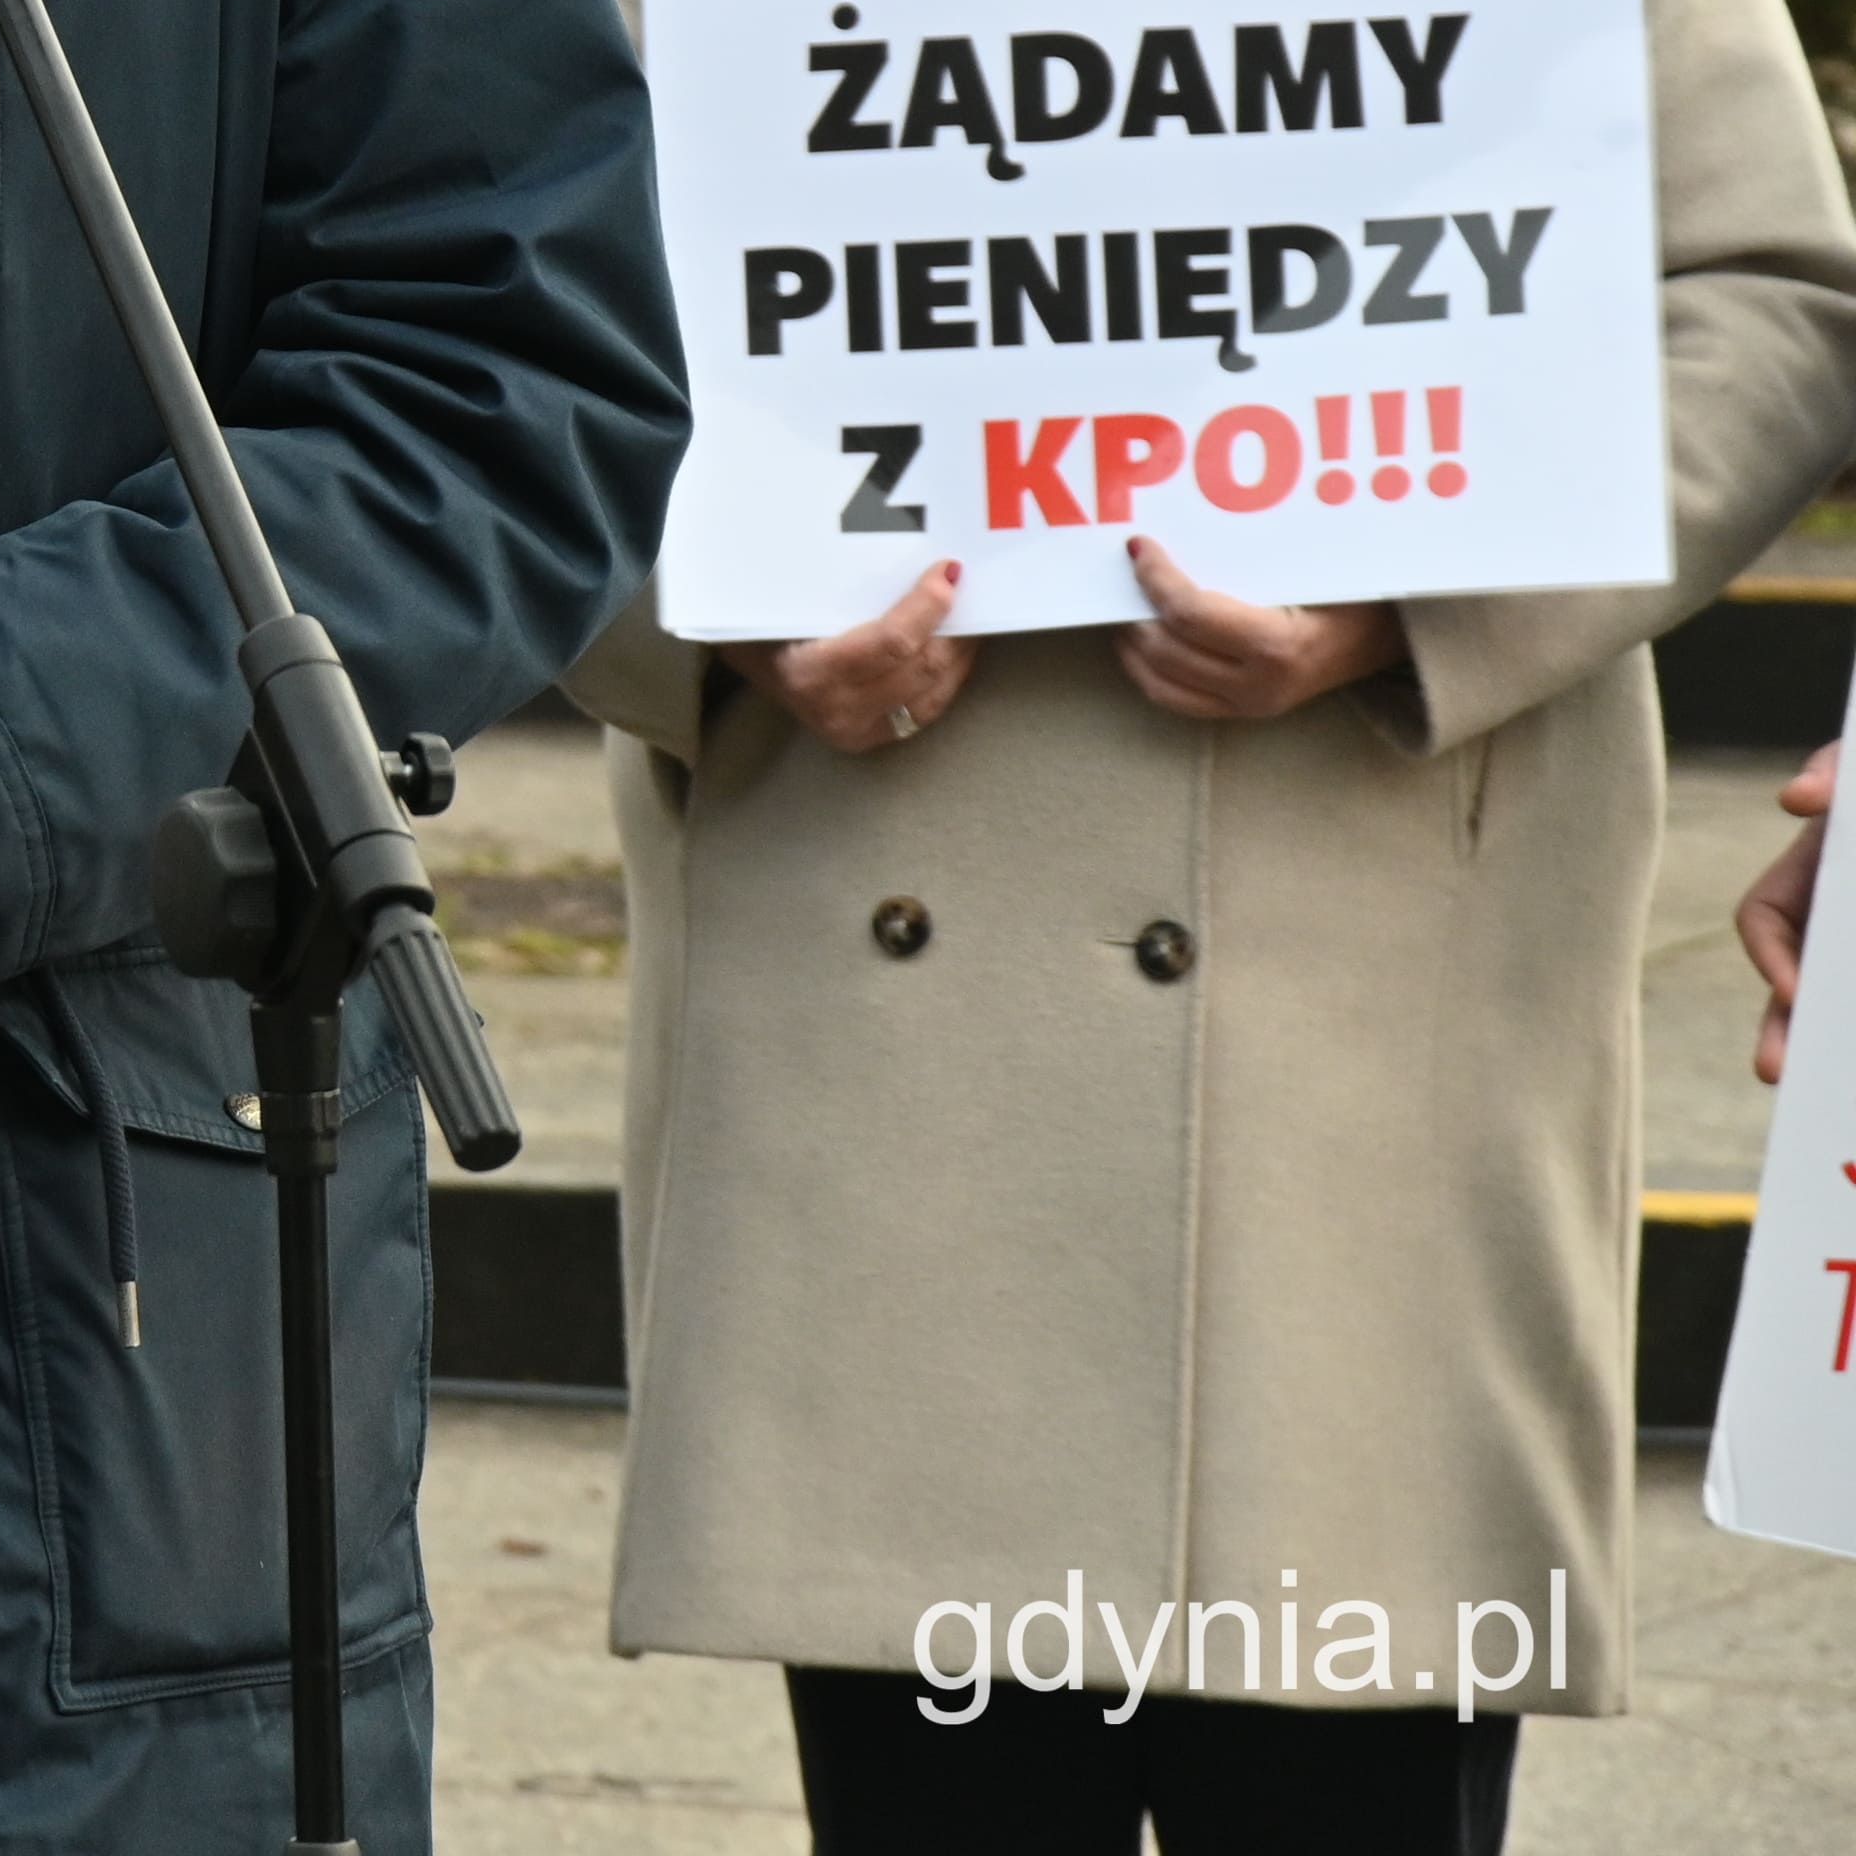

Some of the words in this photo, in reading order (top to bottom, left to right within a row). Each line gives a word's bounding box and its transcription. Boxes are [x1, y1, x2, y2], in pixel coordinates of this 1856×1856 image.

[805, 1, 1472, 182] ŻĄDAMY
[742, 205, 1555, 373] PIENIĘDZY
[837, 423, 927, 534] Z
[981, 384, 1469, 532] KPO!!!
